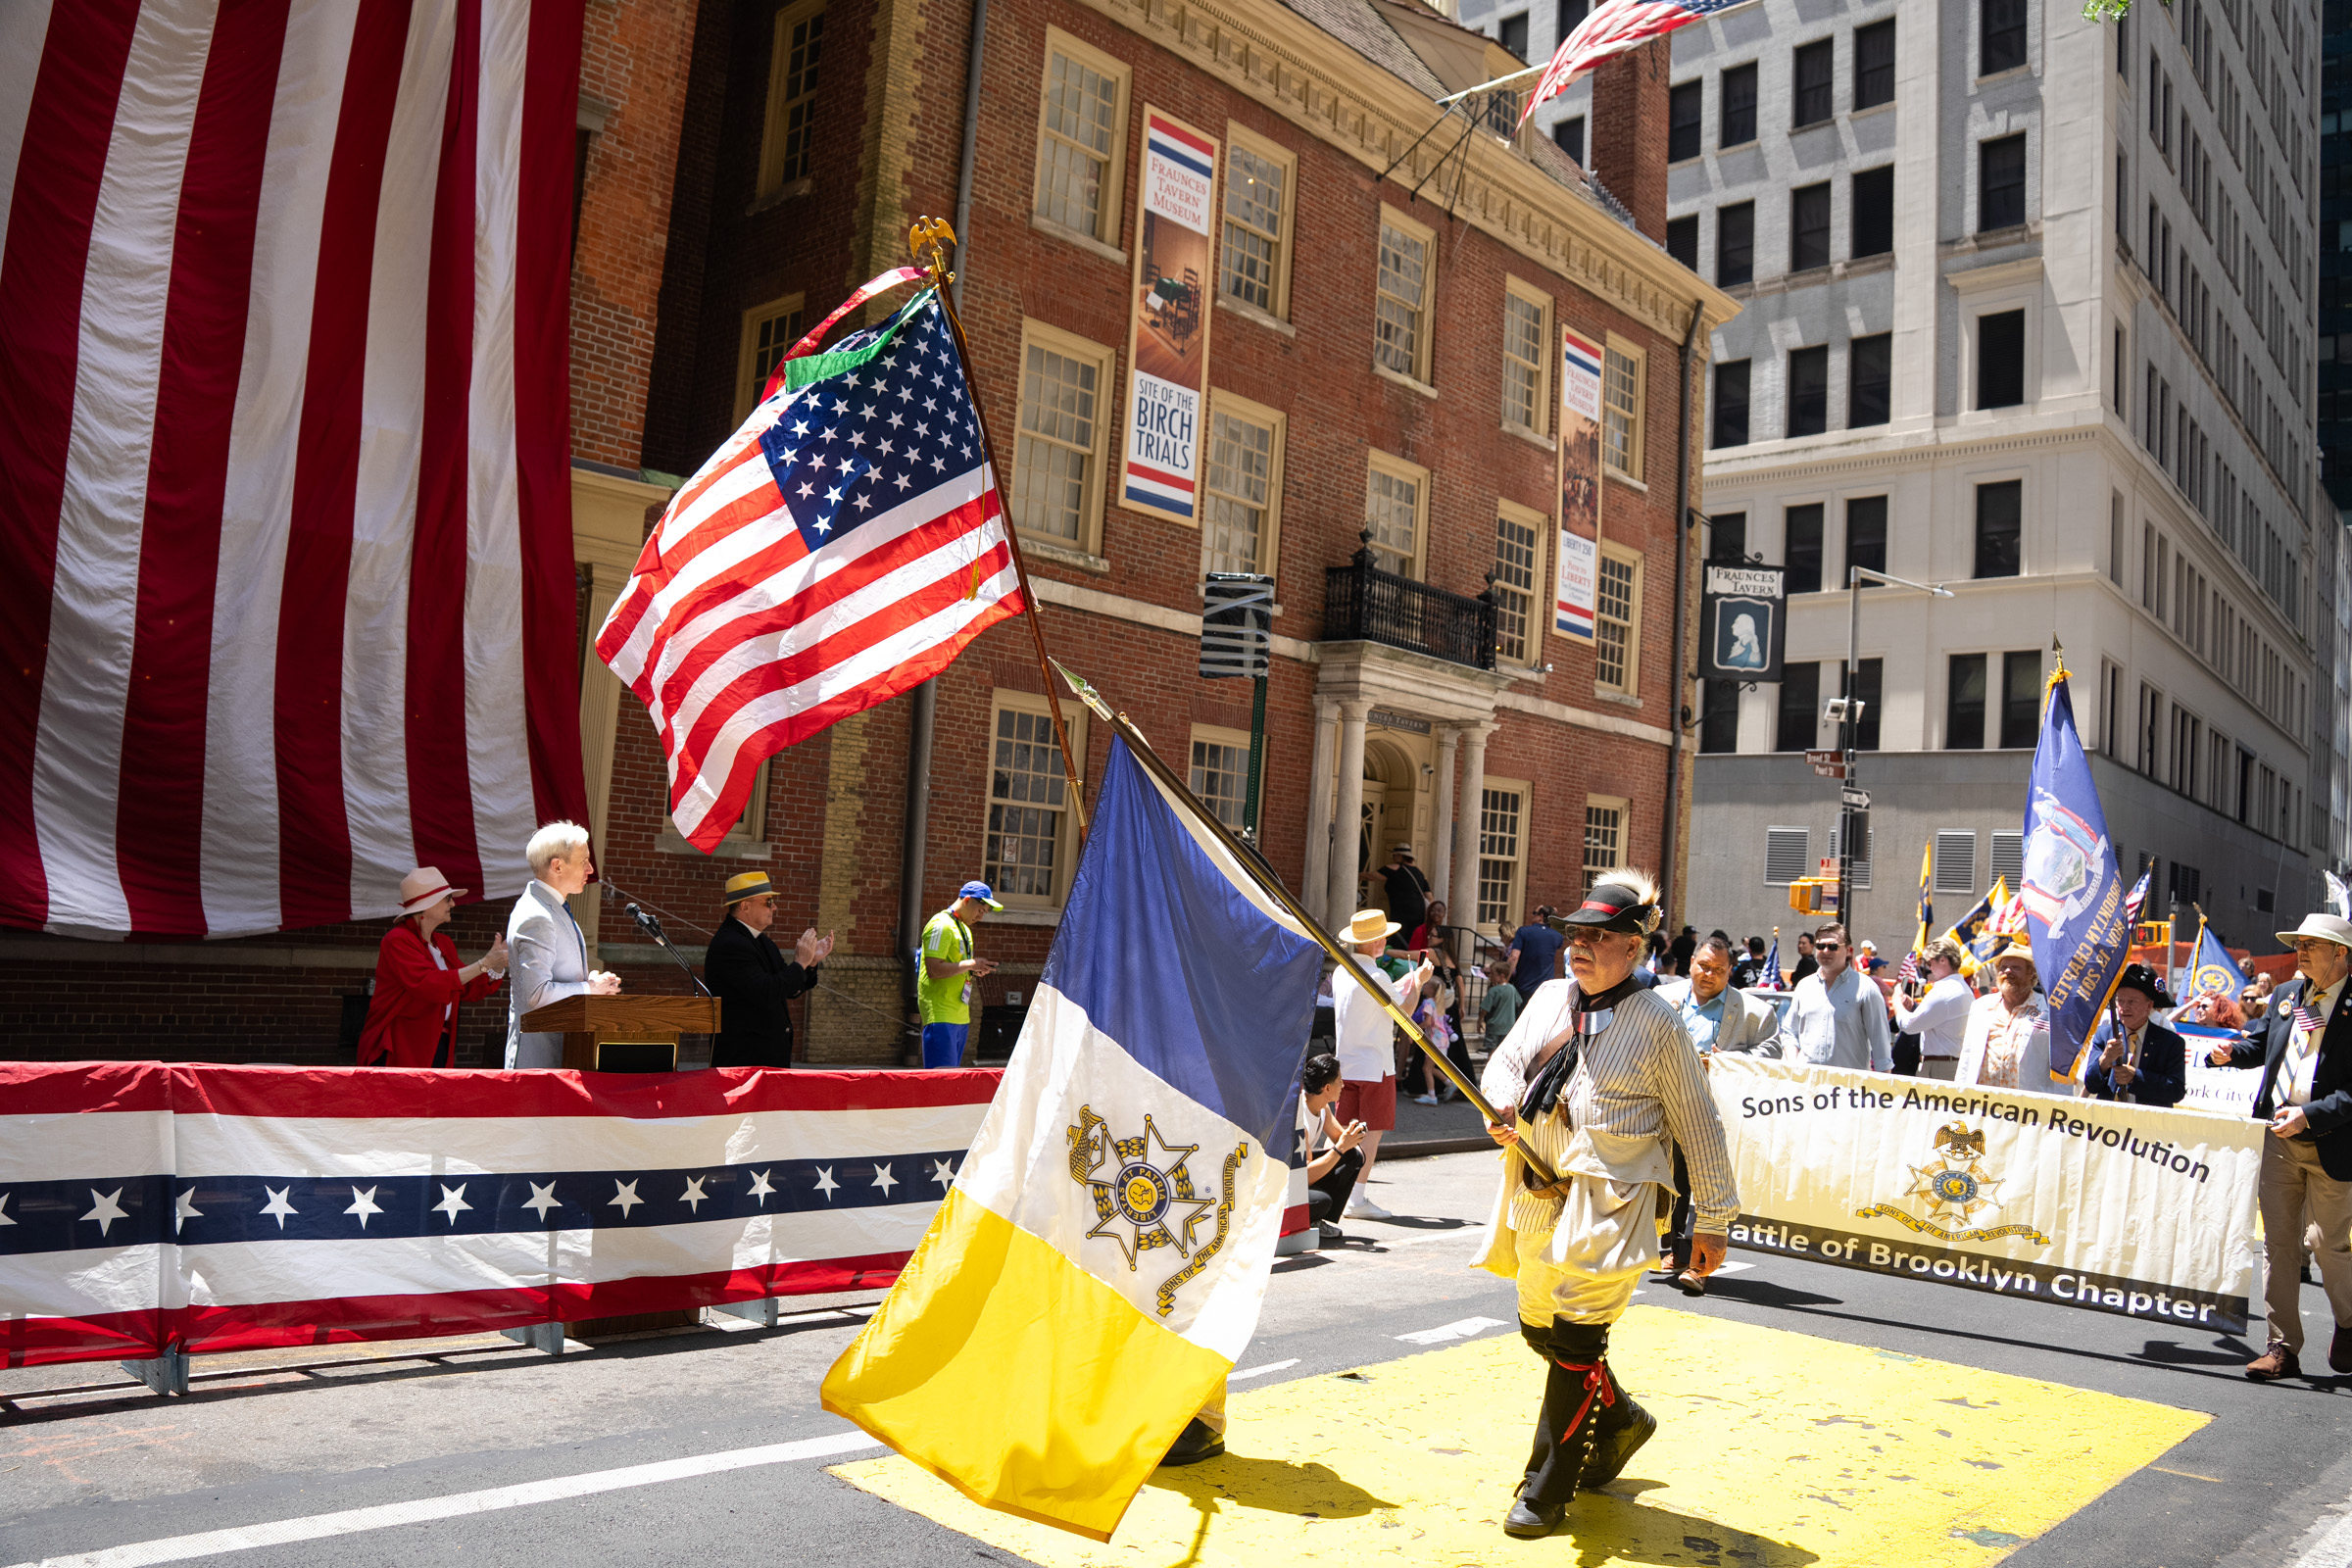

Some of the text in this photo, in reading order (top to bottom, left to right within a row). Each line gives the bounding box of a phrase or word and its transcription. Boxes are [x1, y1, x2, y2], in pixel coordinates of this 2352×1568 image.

[1152, 157, 1206, 195] FRAUNCES
[1153, 191, 1200, 225] MUSEUM
[1139, 378, 1194, 412] SITE OF THE
[1137, 396, 1192, 443] BIRCH
[1136, 429, 1190, 470] TRIALS
[1562, 535, 1582, 553] LIBERTY
[1561, 564, 1592, 588] LIBERTY
[1716, 568, 1775, 583] FRAUNCES
[1732, 580, 1775, 594] TAVERN
[1369, 711, 1393, 722] UNCES
[1807, 754, 1831, 763] Broad St
[1828, 766, 1835, 776] St
[2184, 1083, 2210, 1099] ork
[2215, 1087, 2245, 1105] City
[1741, 1096, 1804, 1118] Sons
[1813, 1086, 1841, 1110] of
[1848, 1086, 1893, 1108] the
[1902, 1088, 2039, 1126] American
[2048, 1107, 2210, 1184] Revolution
[1118, 1168, 1166, 1221] LIBERTAS ET PATRIA
[1159, 1154, 1238, 1296] SONS OF THE AMERICAN REVOLUTION
[1880, 1204, 2031, 1241] SONS OF THE AMERICAN REVOLUTION
[1821, 1237, 1860, 1261] of
[1869, 1243, 2037, 1292] Brooklyn
[2051, 1273, 2217, 1322] Chapter
